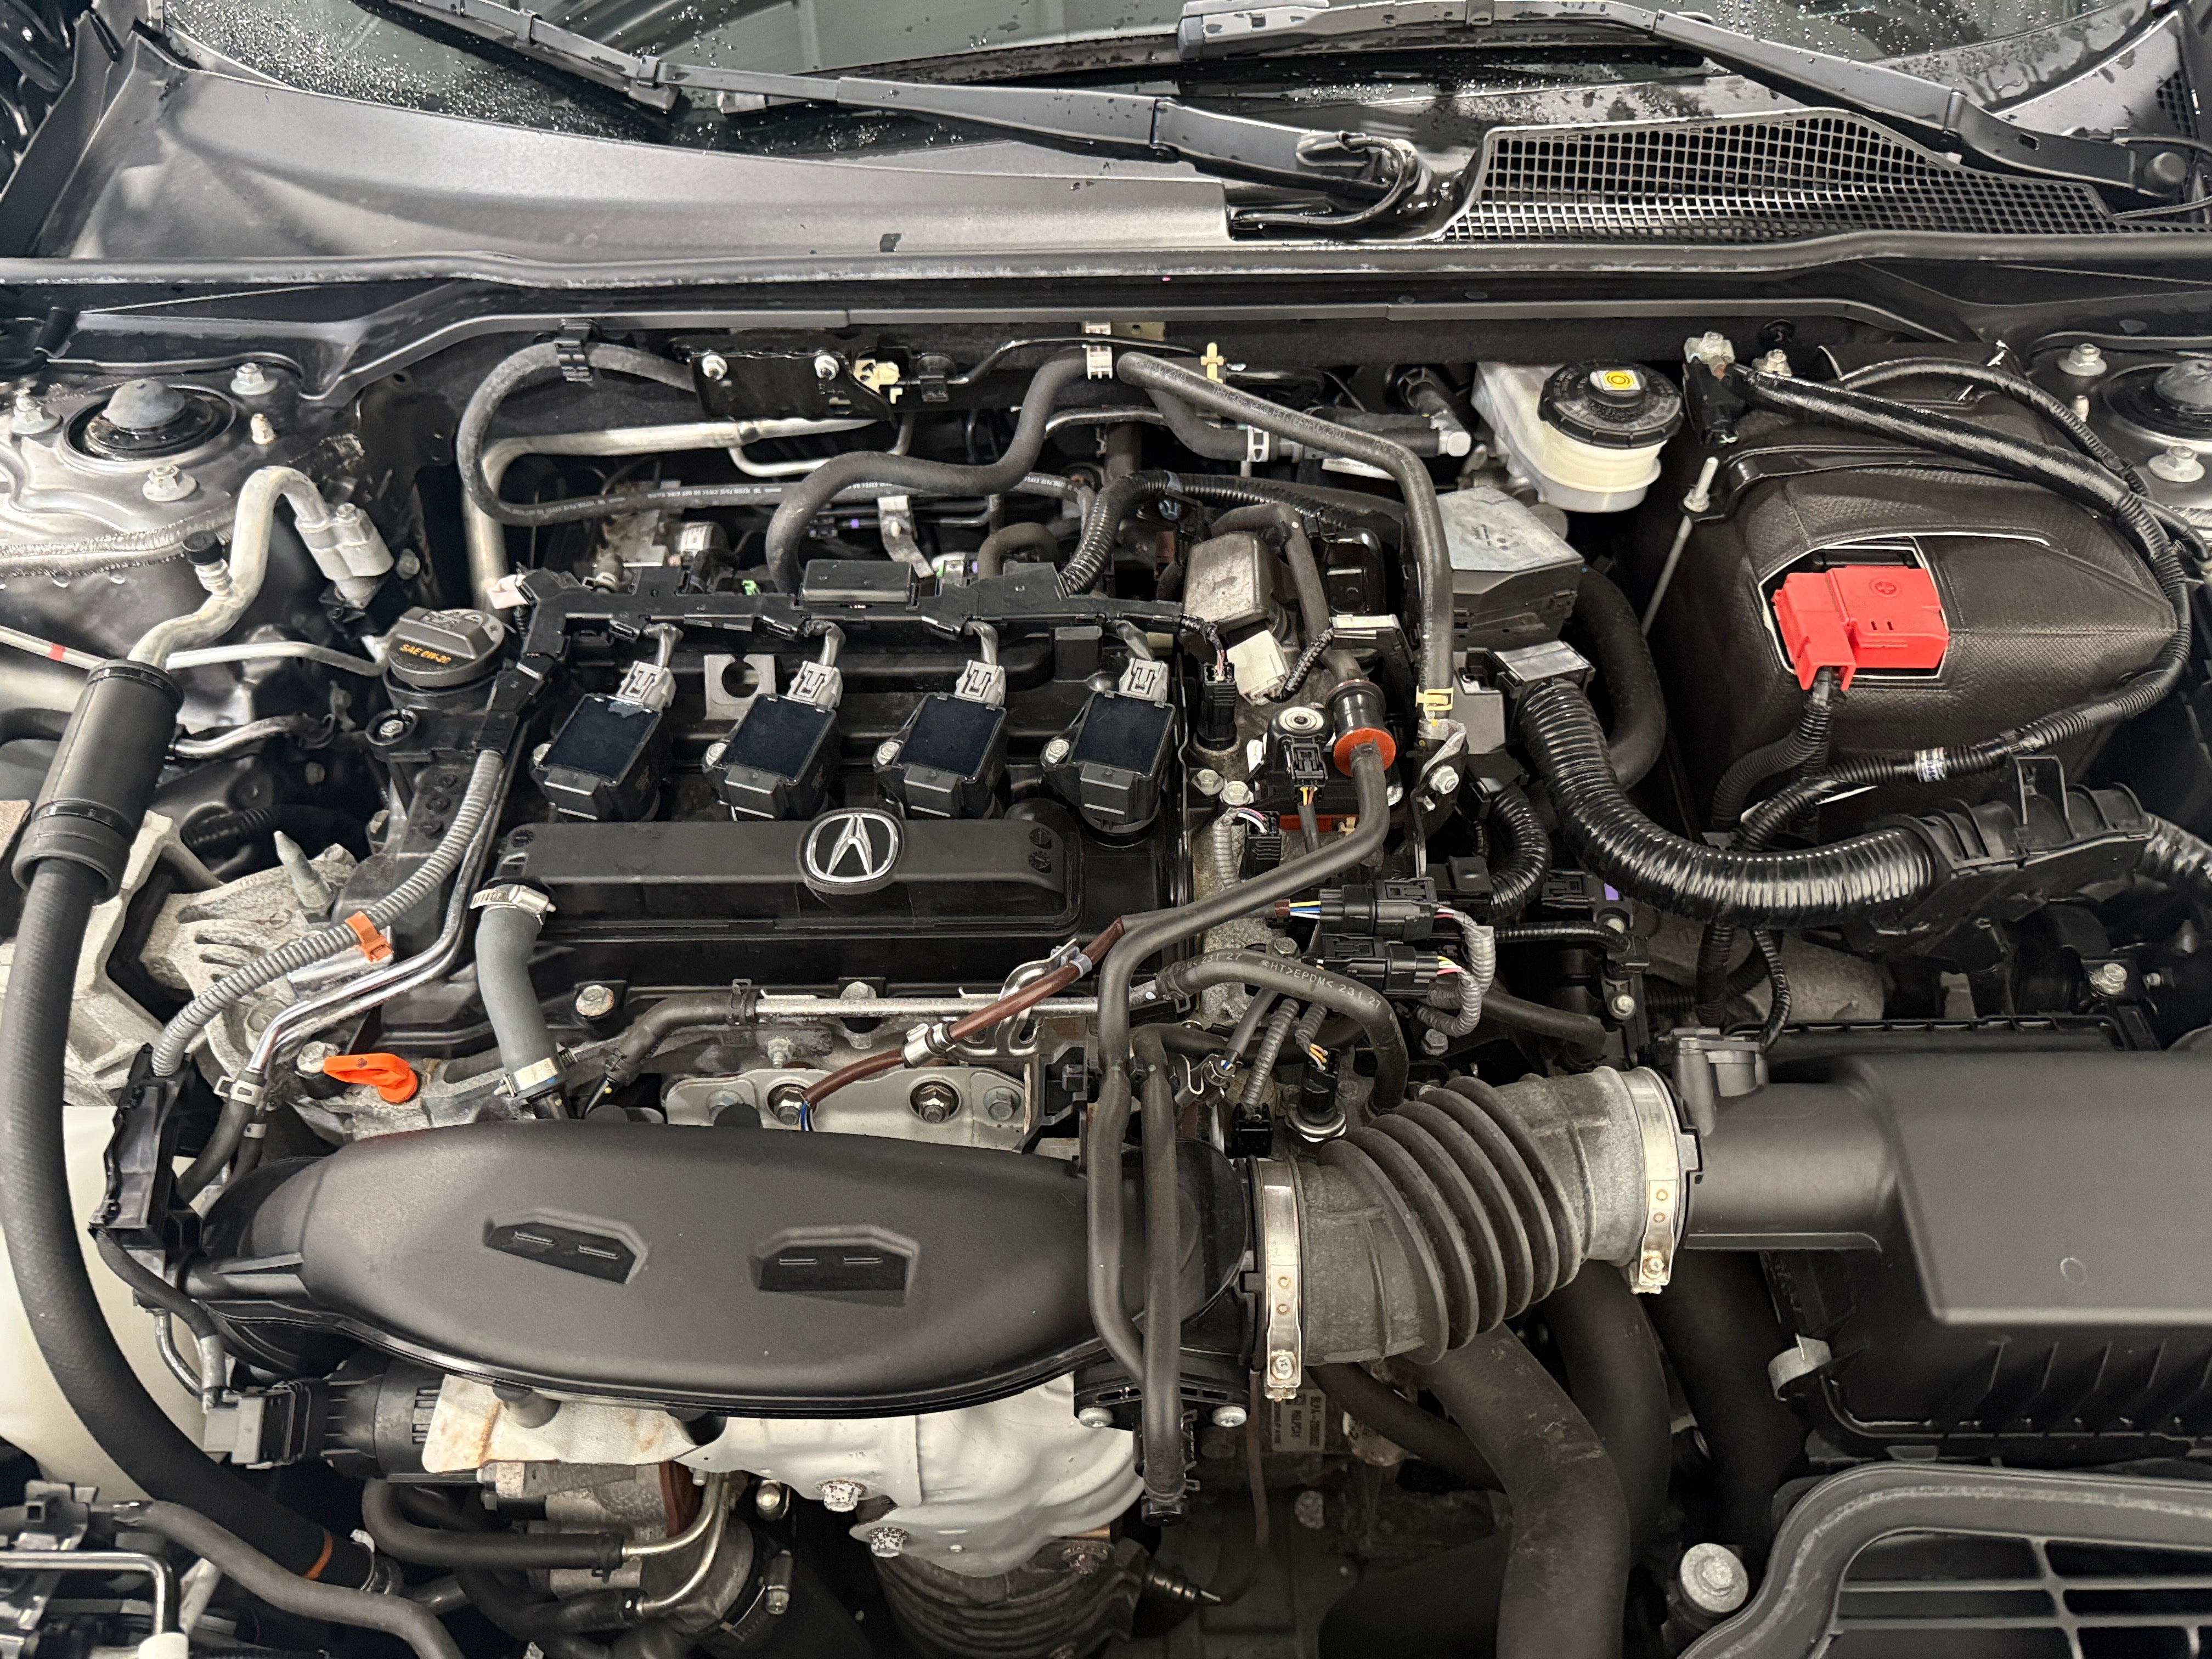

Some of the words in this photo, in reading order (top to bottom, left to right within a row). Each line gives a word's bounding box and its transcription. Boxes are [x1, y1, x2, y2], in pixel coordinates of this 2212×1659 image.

[399, 644, 423, 656] SAE
[420, 651, 452, 664] 0W-20
[1226, 952, 1242, 961] 27
[1368, 996, 1382, 1009] 27
